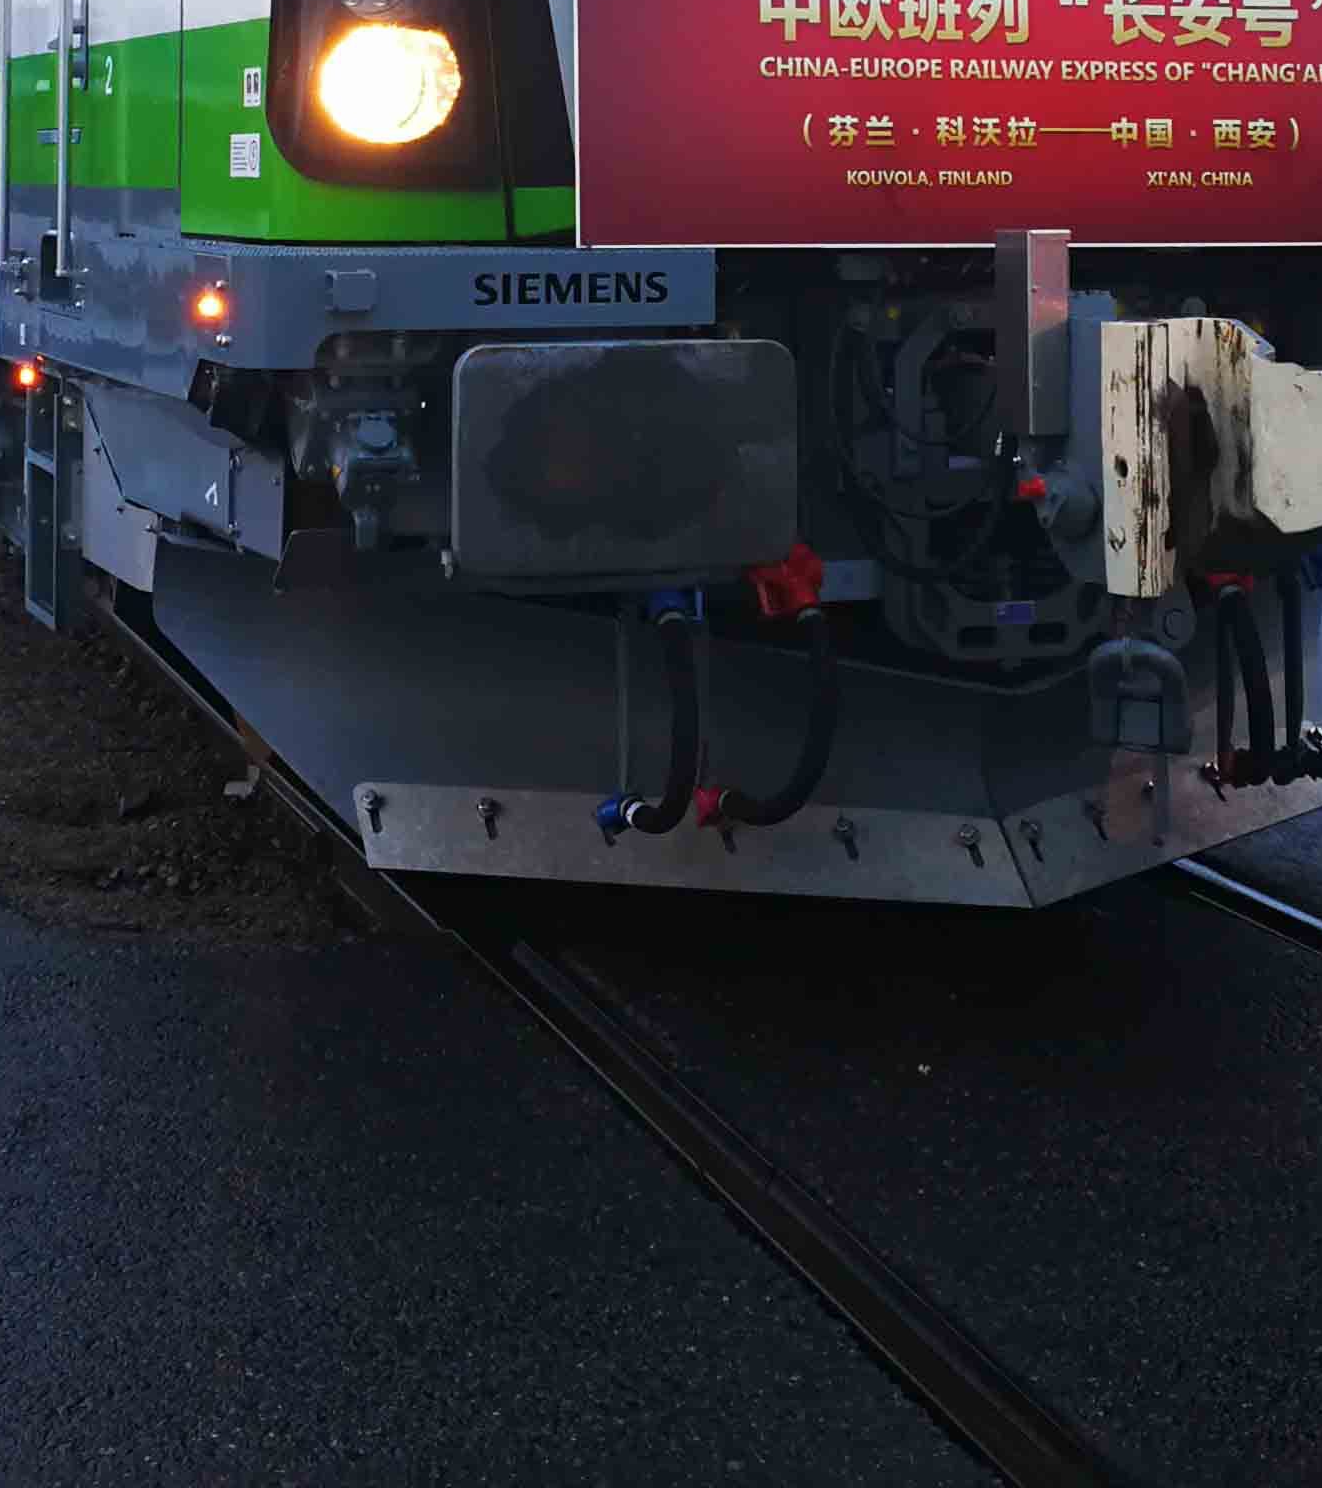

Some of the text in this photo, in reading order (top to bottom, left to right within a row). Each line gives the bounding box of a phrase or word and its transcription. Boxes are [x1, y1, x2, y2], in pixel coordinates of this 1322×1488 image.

[105, 55, 113, 96] 2
[759, 56, 943, 79] CHINA-EUROPE
[949, 59, 1054, 80] RAILWAY
[1061, 60, 1158, 81] EXPRESS
[1164, 62, 1195, 82] OF
[846, 169, 1013, 187] KOUVOLA, FINLAND
[1200, 171, 1254, 187] CHINA
[473, 271, 669, 306] SIEMENS
